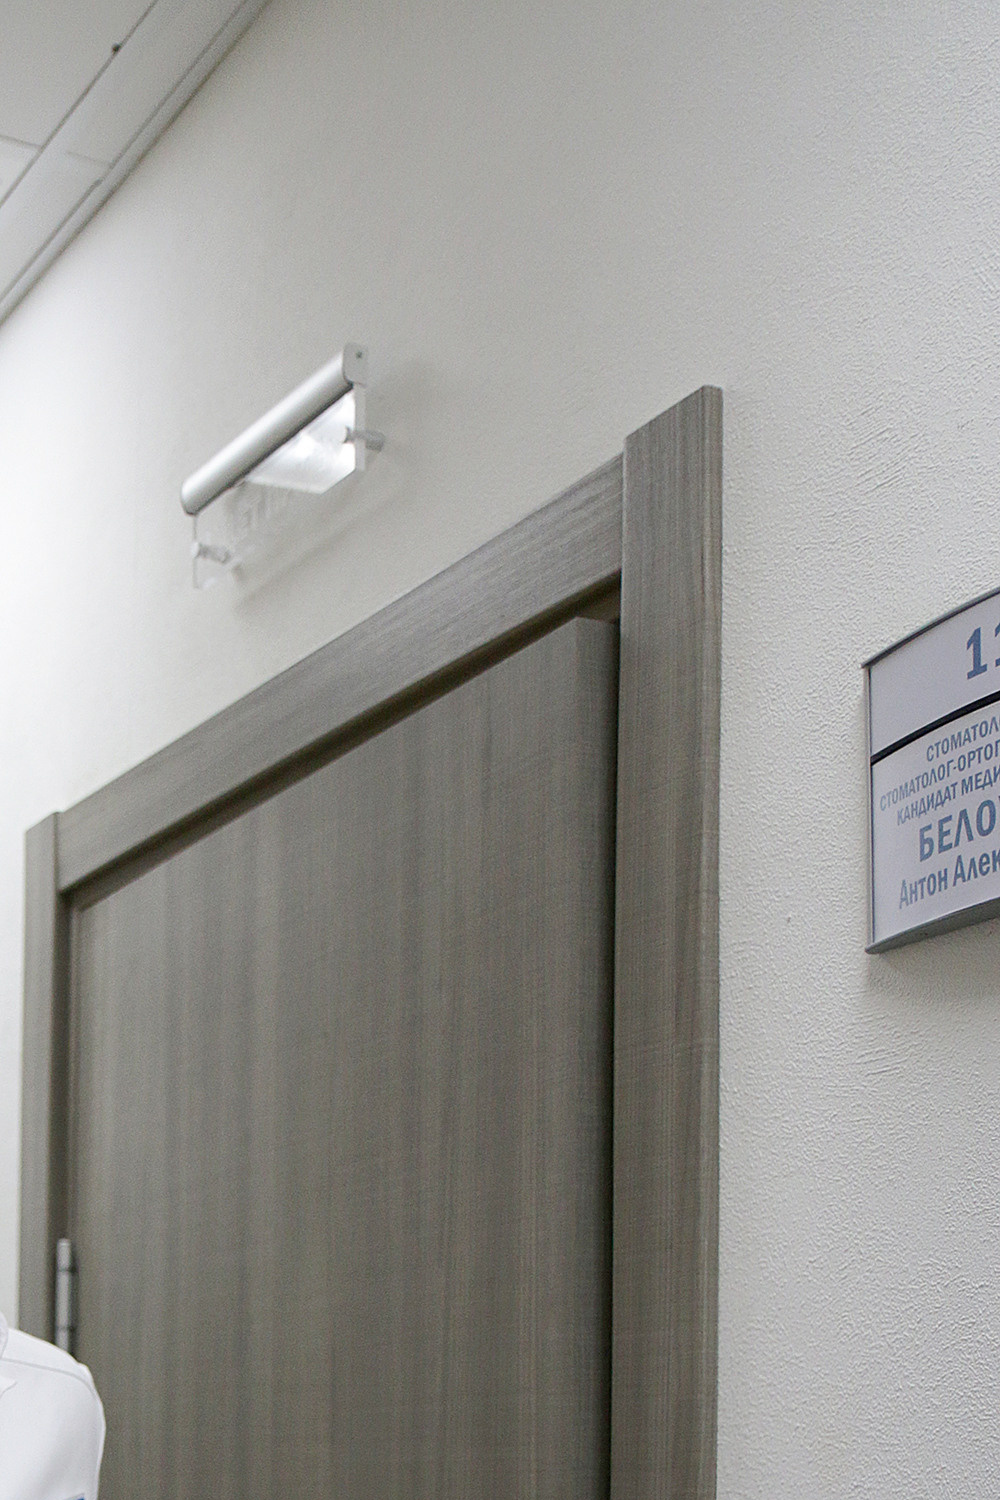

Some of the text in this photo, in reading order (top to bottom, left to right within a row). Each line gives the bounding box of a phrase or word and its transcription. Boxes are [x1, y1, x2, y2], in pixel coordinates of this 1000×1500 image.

[966, 624, 1000, 680] 1
[926, 715, 1000, 762] СТОМАТОЛ
[896, 781, 959, 826] КАНДИДАТ
[919, 795, 1000, 862] БЕЛО
[899, 867, 949, 909] Антон
